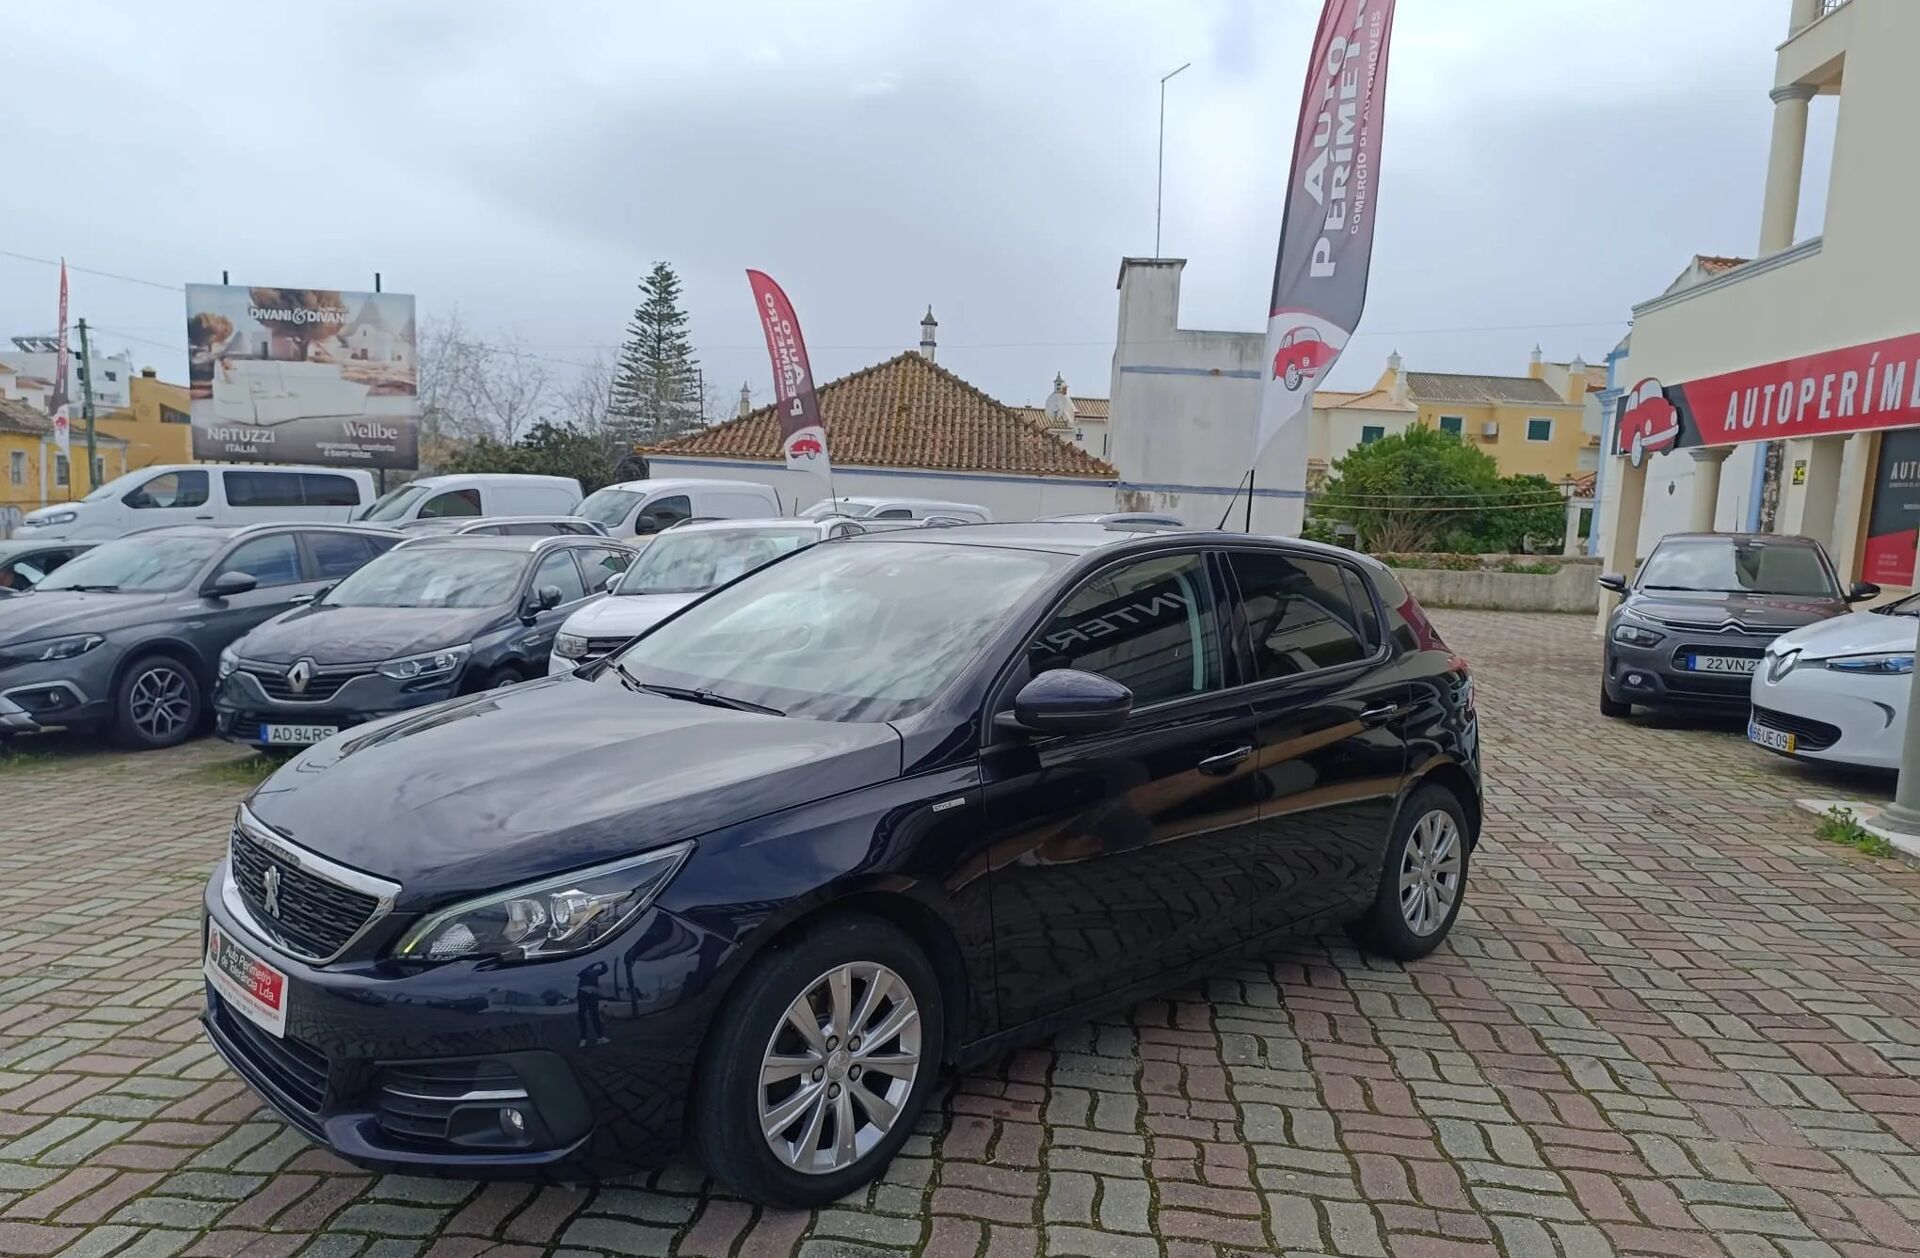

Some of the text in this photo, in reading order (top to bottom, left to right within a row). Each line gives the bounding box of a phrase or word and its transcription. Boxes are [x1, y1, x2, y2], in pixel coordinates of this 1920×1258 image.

[1304, 35, 1346, 206] AUTO
[1350, 11, 1380, 235] COMÉRCIO DE AUTOMÓVEIS
[207, 427, 275, 443] NATUZZI
[343, 422, 398, 439] Wellbe
[1707, 658, 1761, 671] 22 VN 2
